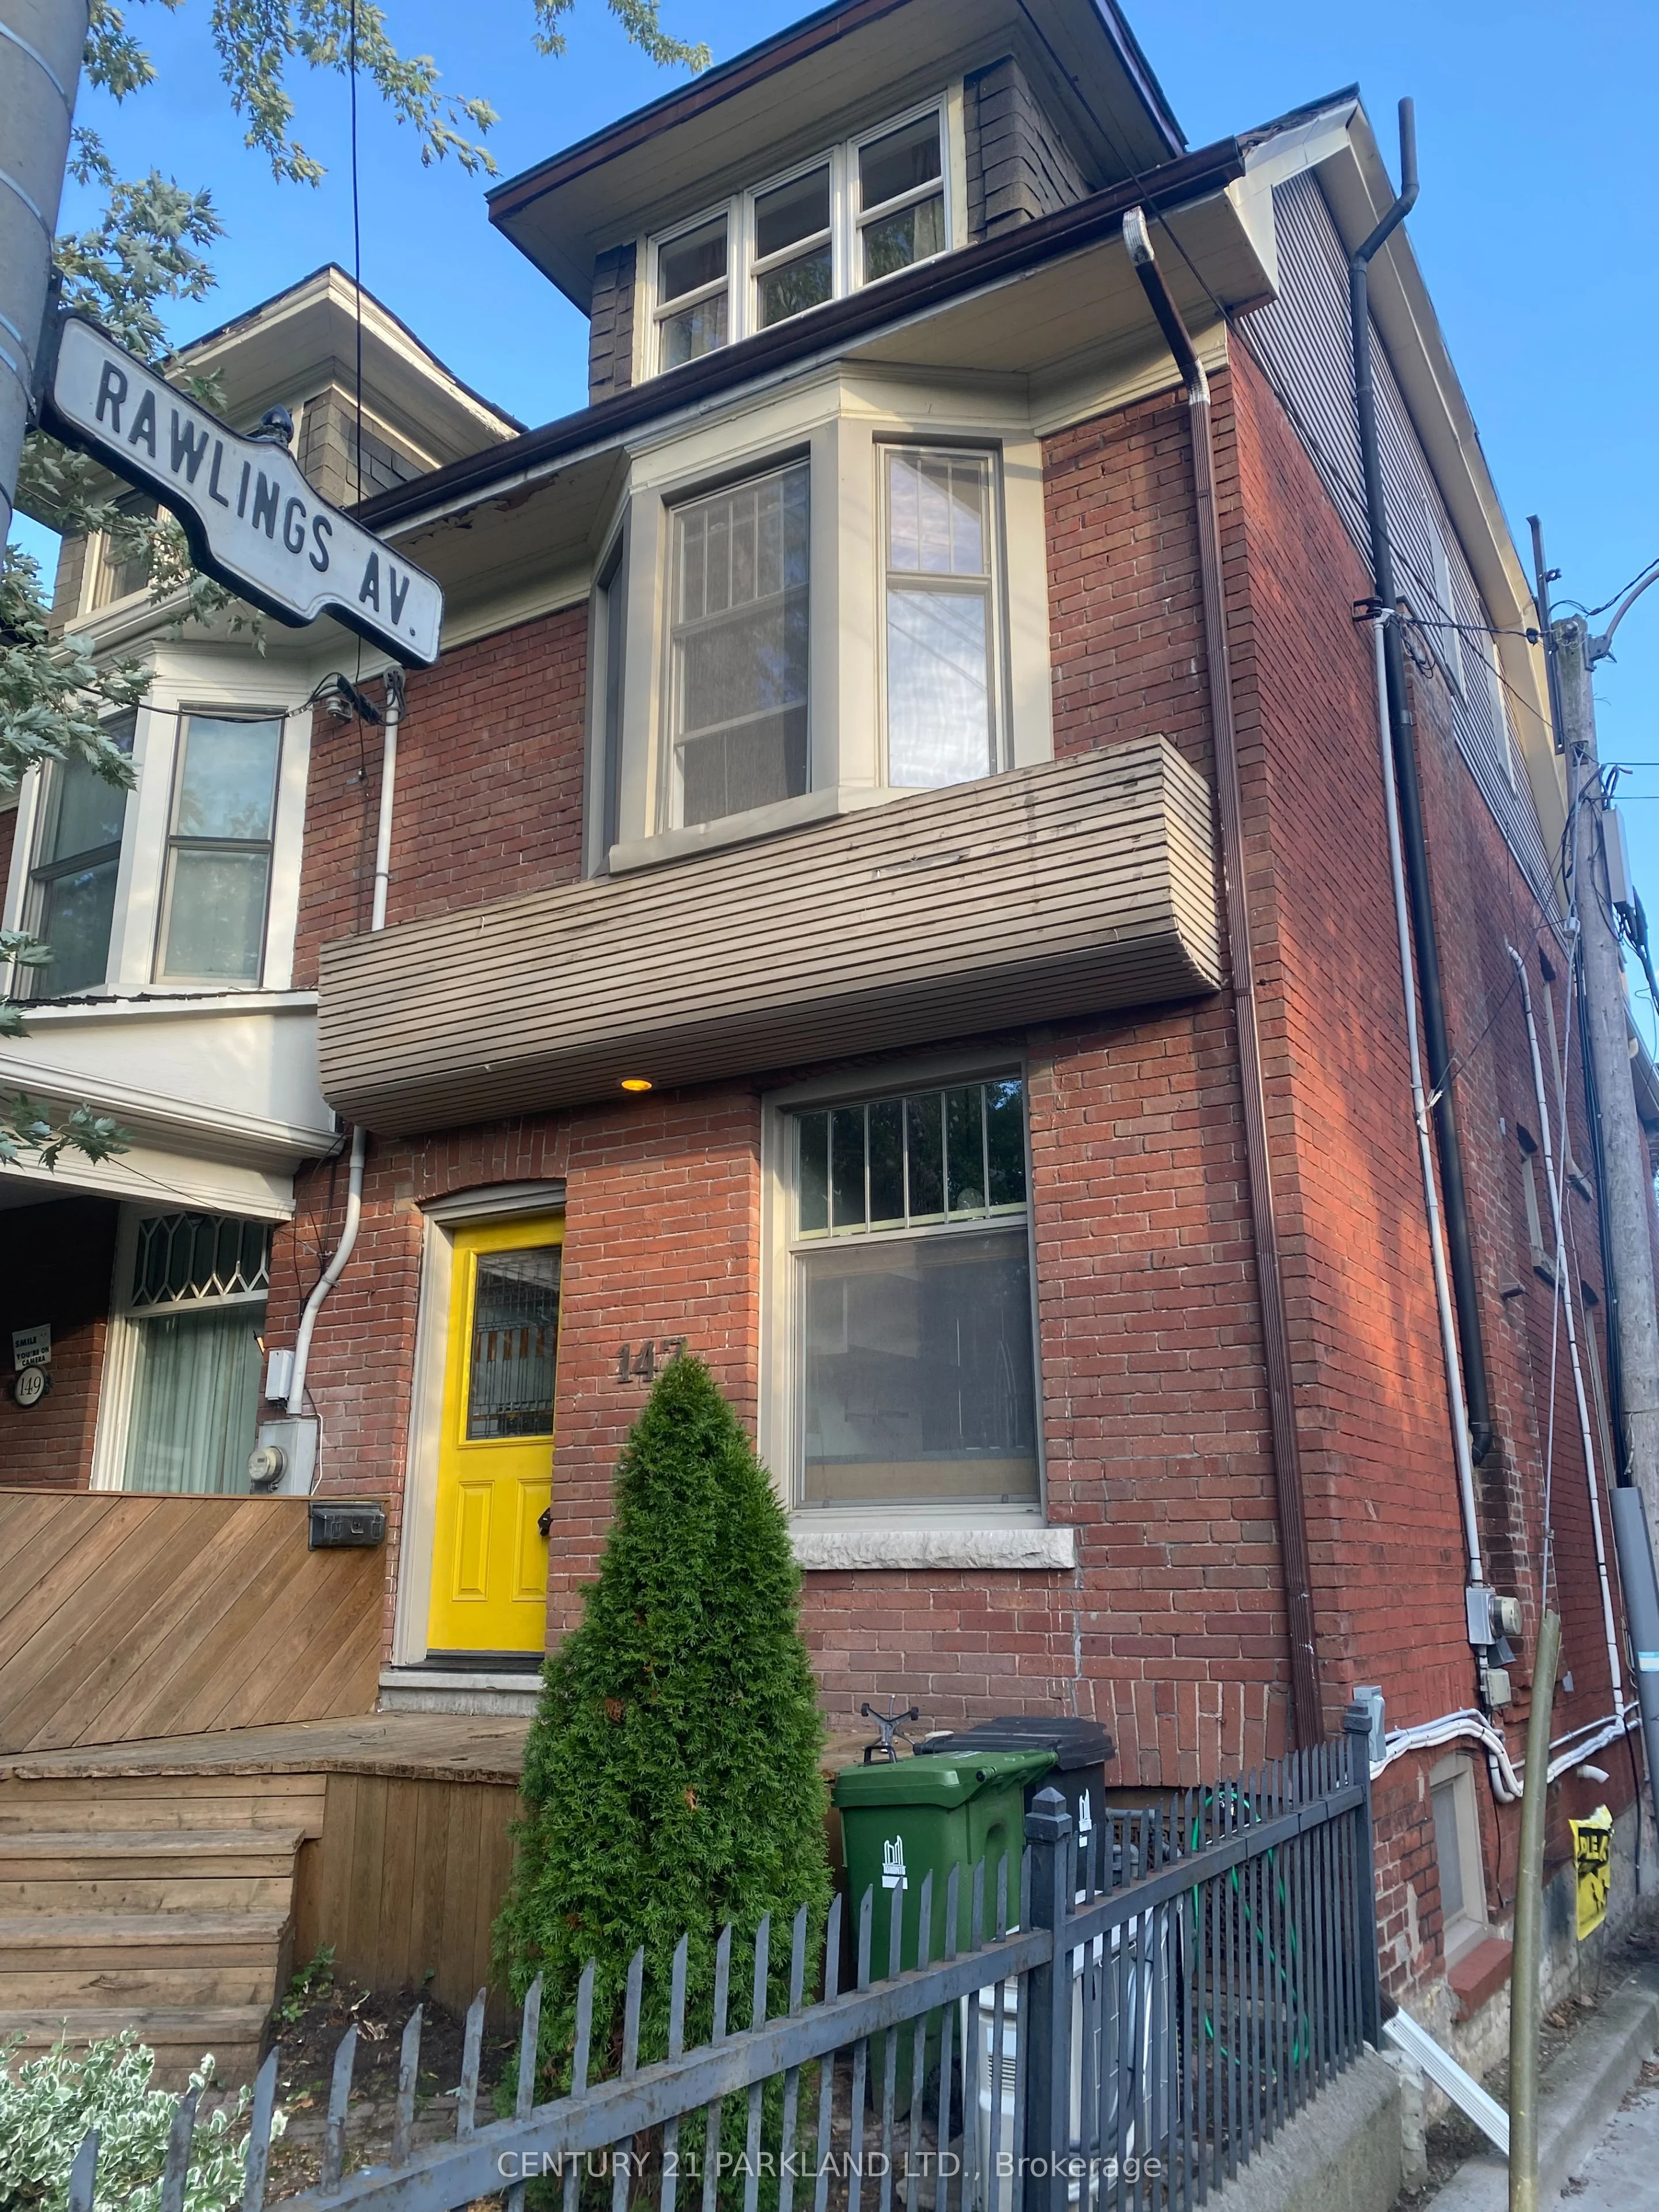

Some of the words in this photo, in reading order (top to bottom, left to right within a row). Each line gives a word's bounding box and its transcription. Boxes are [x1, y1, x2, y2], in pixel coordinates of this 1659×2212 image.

[94, 359, 332, 573] RAWLINGS
[358, 551, 409, 624] AV
[15, 1336, 37, 1348] SMILE
[16, 1349, 39, 1360] YOU'RE
[22, 1355, 46, 1366] CAMERA
[19, 1376, 41, 1396] 149
